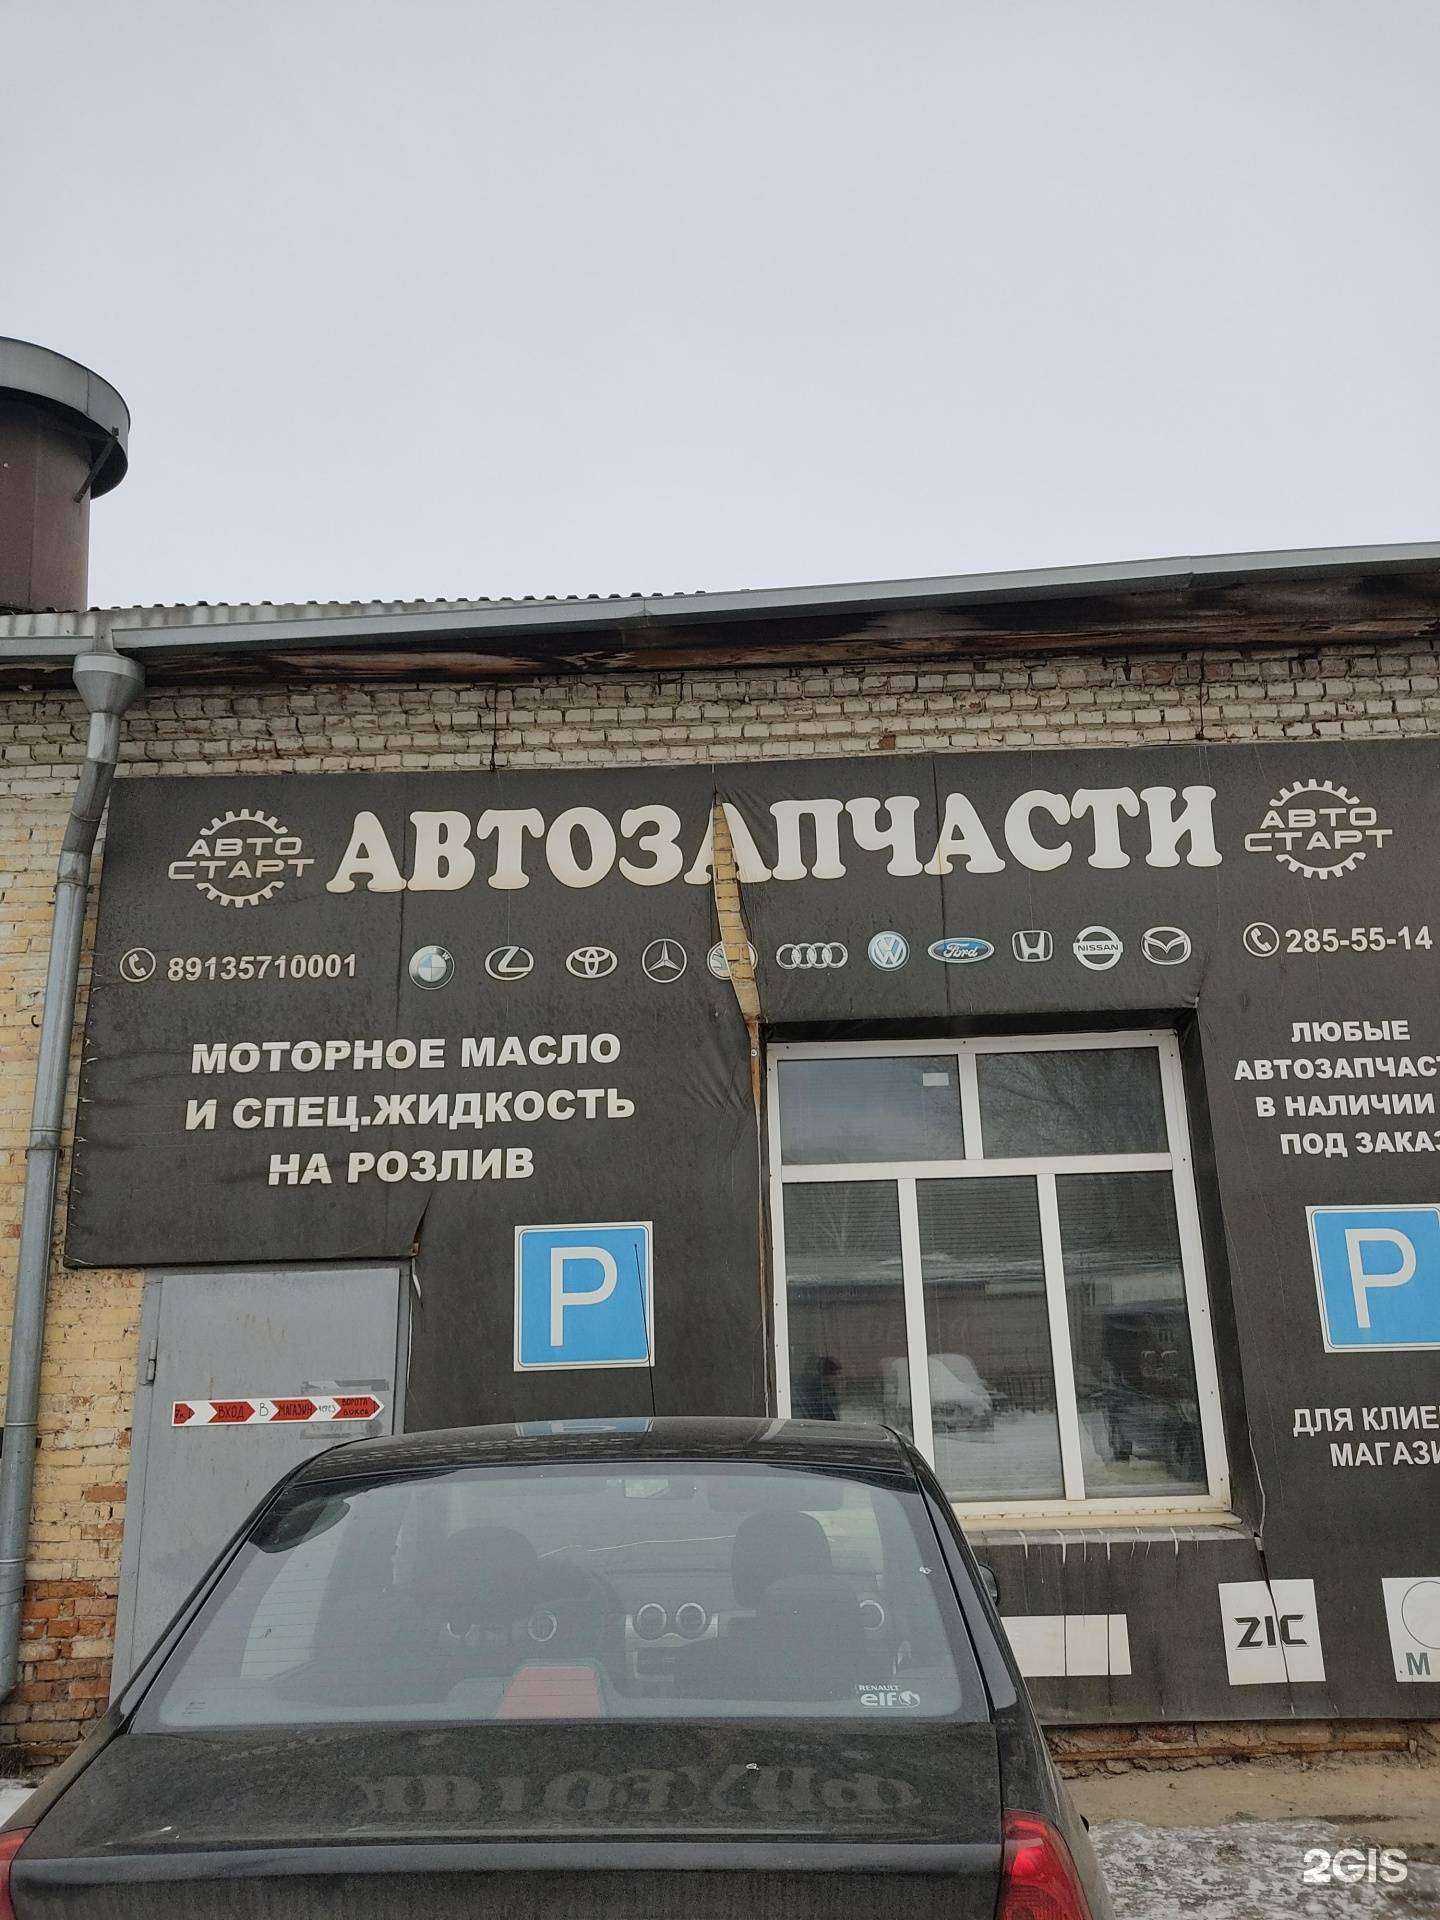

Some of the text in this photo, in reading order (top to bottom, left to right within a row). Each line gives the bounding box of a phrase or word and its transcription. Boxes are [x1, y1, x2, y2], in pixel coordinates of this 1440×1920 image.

[1260, 807, 1377, 829] АВТО
[186, 837, 302, 857] АВТО
[327, 786, 1223, 893] АВТОЗАПЧАСТИ
[1244, 829, 1393, 855] СТАРТ
[168, 859, 315, 879] СТАРТ
[1077, 942, 1120, 953] NISSAN
[1285, 925, 1434, 953] 285-55-14
[167, 953, 357, 981] 89135710001
[1291, 1019, 1411, 1043] ЛЮБЫЕ
[191, 1033, 621, 1074] МОТОРНОЕ МАСЛО
[1234, 1055, 1440, 1081] АВТОЗАПЧАС
[185, 1088, 635, 1133] И СПЕЦ.ЖИДКОСТЬ
[1255, 1093, 1436, 1117] В НАЛИЧИИ
[1280, 1133, 1349, 1158] ПОД
[268, 1147, 534, 1186] НА РОЗЛИВ
[1344, 1228, 1417, 1328] P
[550, 1246, 618, 1347] P
[218, 1405, 245, 1419] ВХОД
[1292, 1405, 1440, 1437] ДЛЯ КЛИЕ
[1232, 1614, 1310, 1650] ZIC
[860, 1691, 898, 1706] elf
